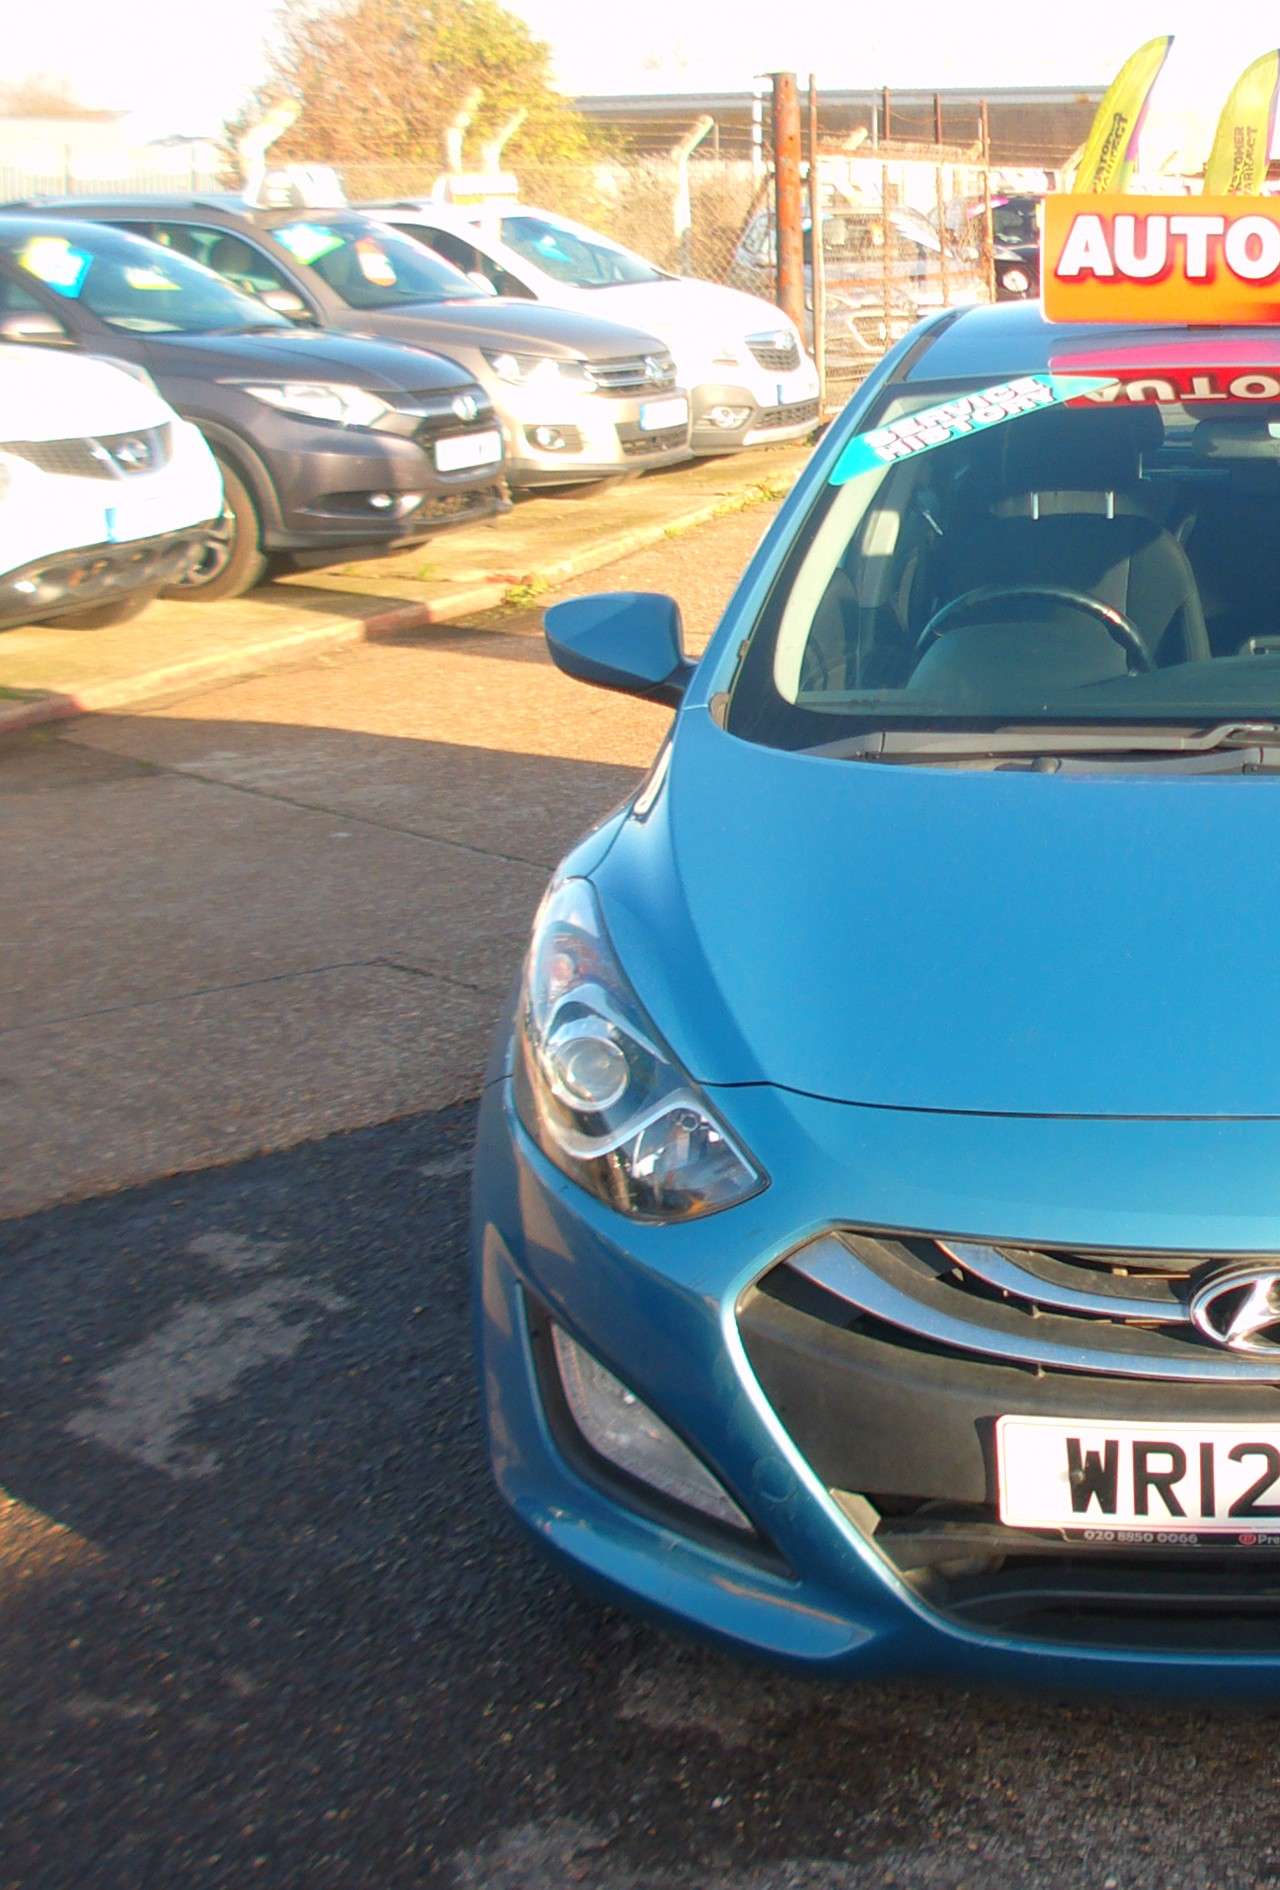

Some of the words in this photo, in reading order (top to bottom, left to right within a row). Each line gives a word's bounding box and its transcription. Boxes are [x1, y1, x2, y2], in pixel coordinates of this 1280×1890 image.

[863, 376, 1048, 449] SERVICE
[874, 384, 1057, 463] HISTORY
[1084, 1530, 1115, 1541] 020
[1117, 1531, 1153, 1543] 8850
[1157, 1533, 1198, 1544] 0066
